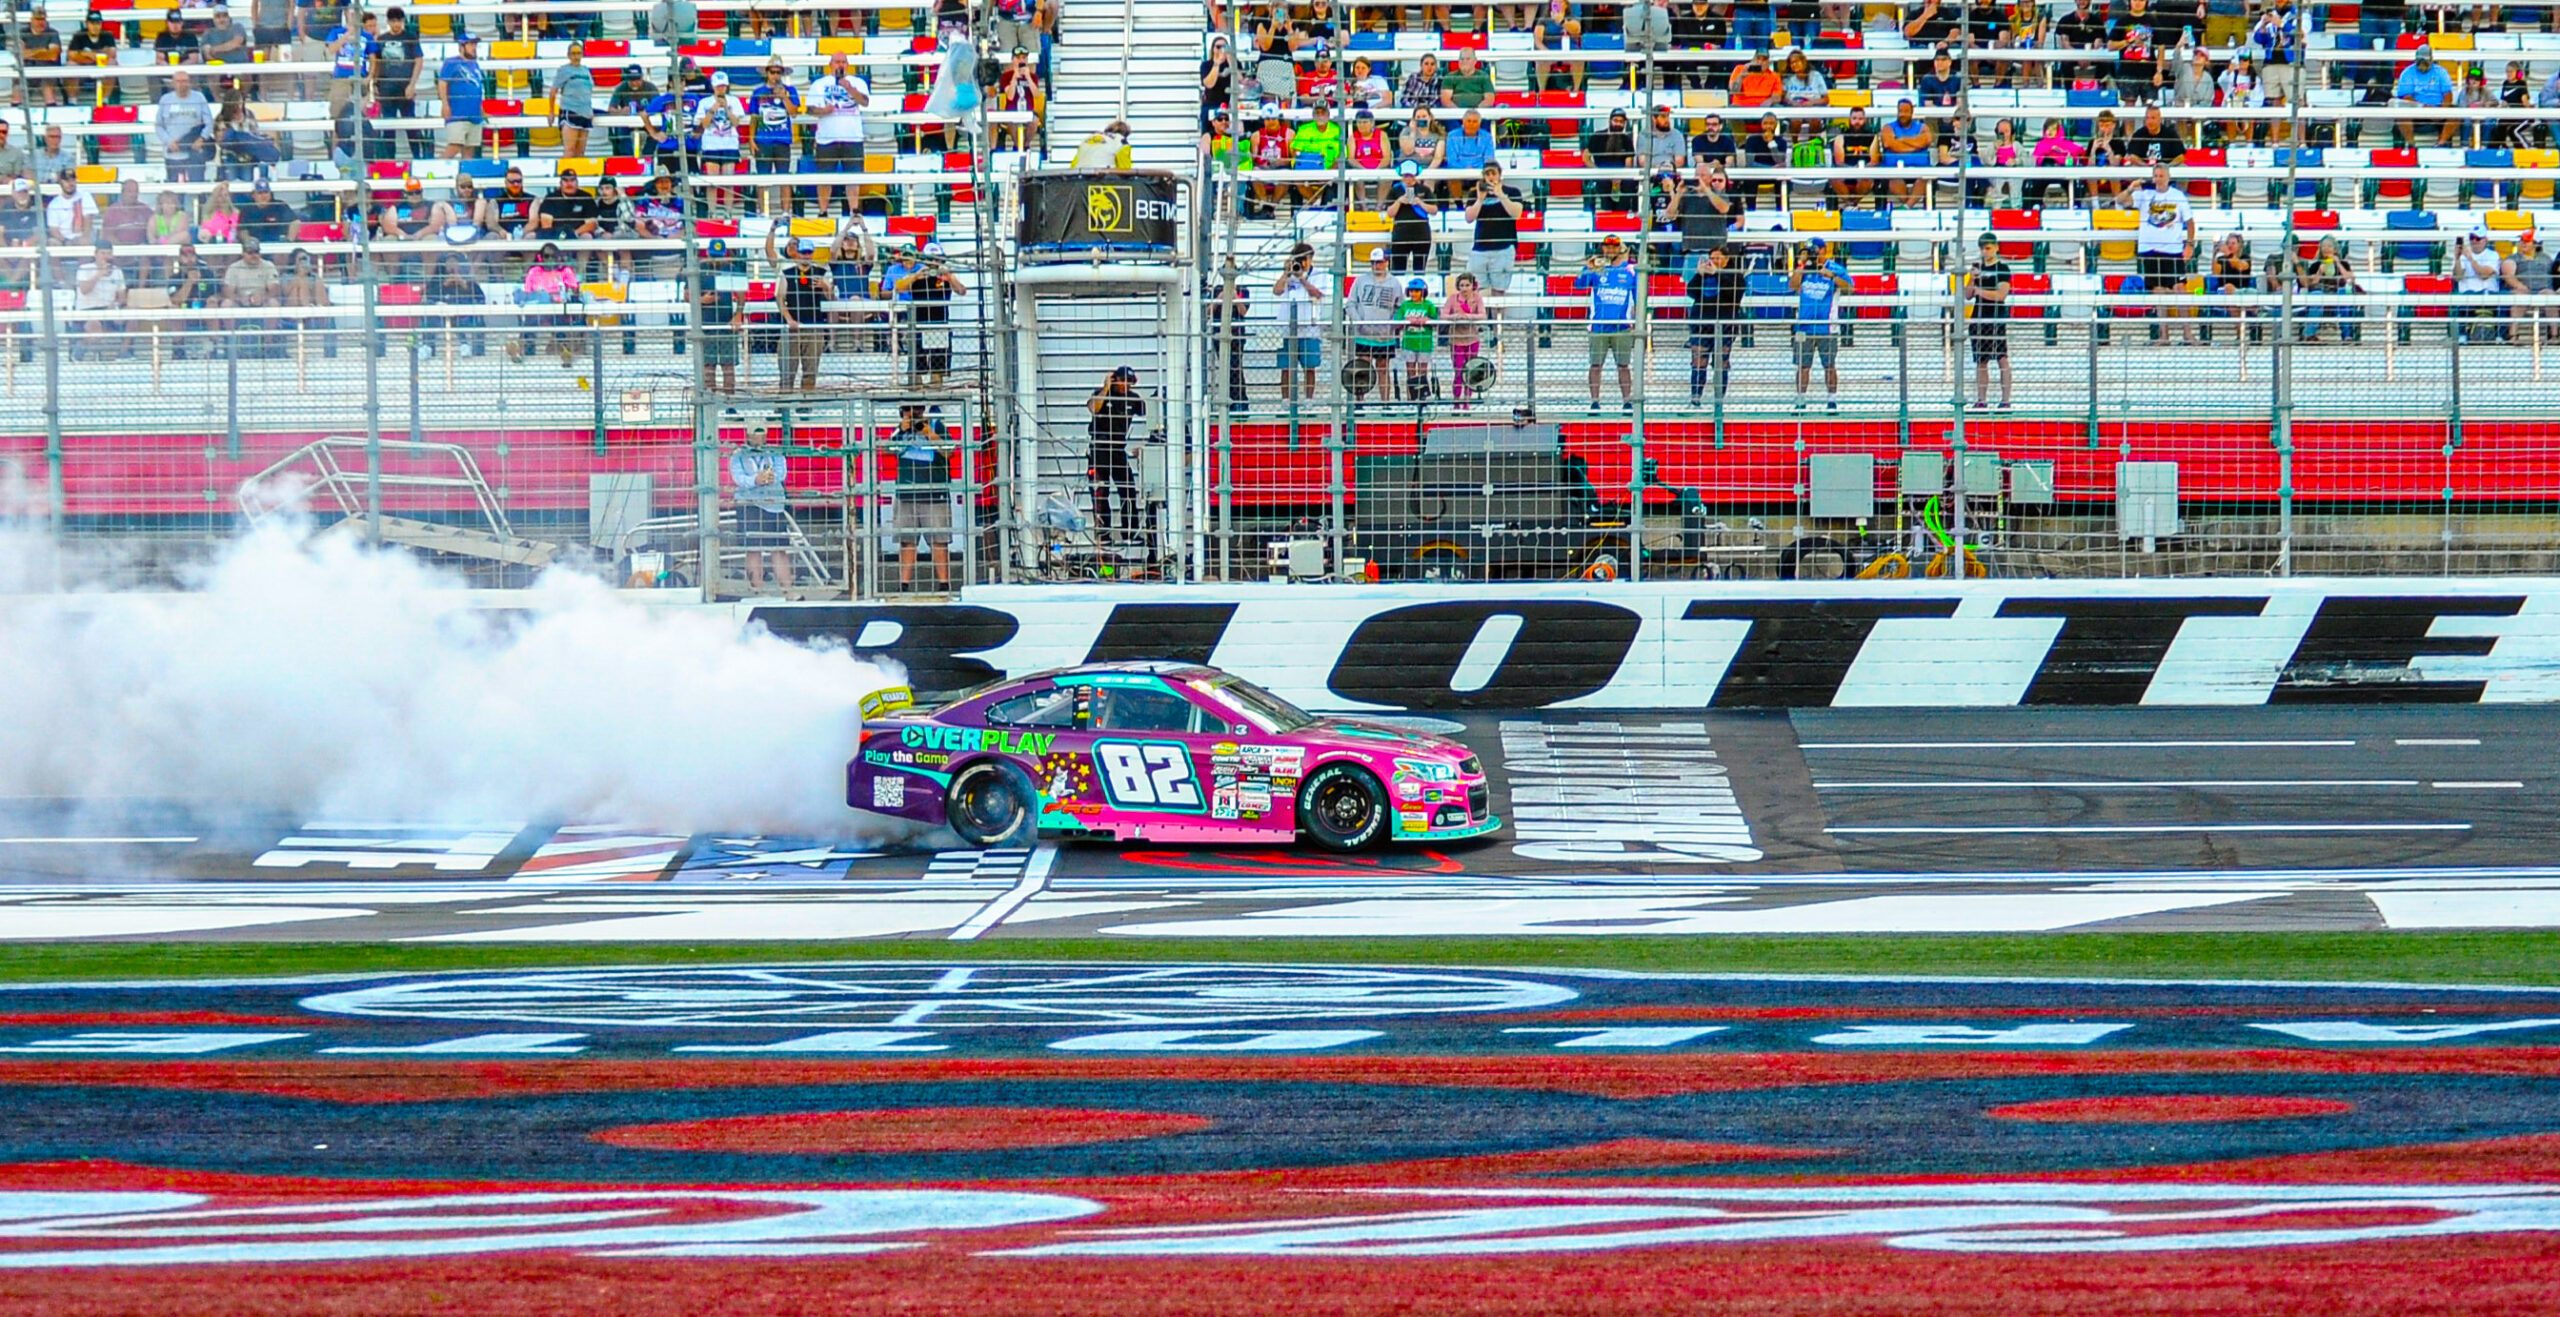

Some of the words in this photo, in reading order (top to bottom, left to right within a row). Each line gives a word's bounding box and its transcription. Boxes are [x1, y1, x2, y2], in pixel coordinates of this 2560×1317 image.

[865, 749, 891, 764] Play
[893, 750, 913, 763] the
[915, 752, 949, 765] Game
[901, 725, 1056, 756] OVERPLAY
[1100, 744, 1200, 805] 82
[1304, 767, 1342, 810] GENERAL
[1499, 720, 1764, 863] CHARLOTTE
[1344, 803, 1382, 847] GENERAL
